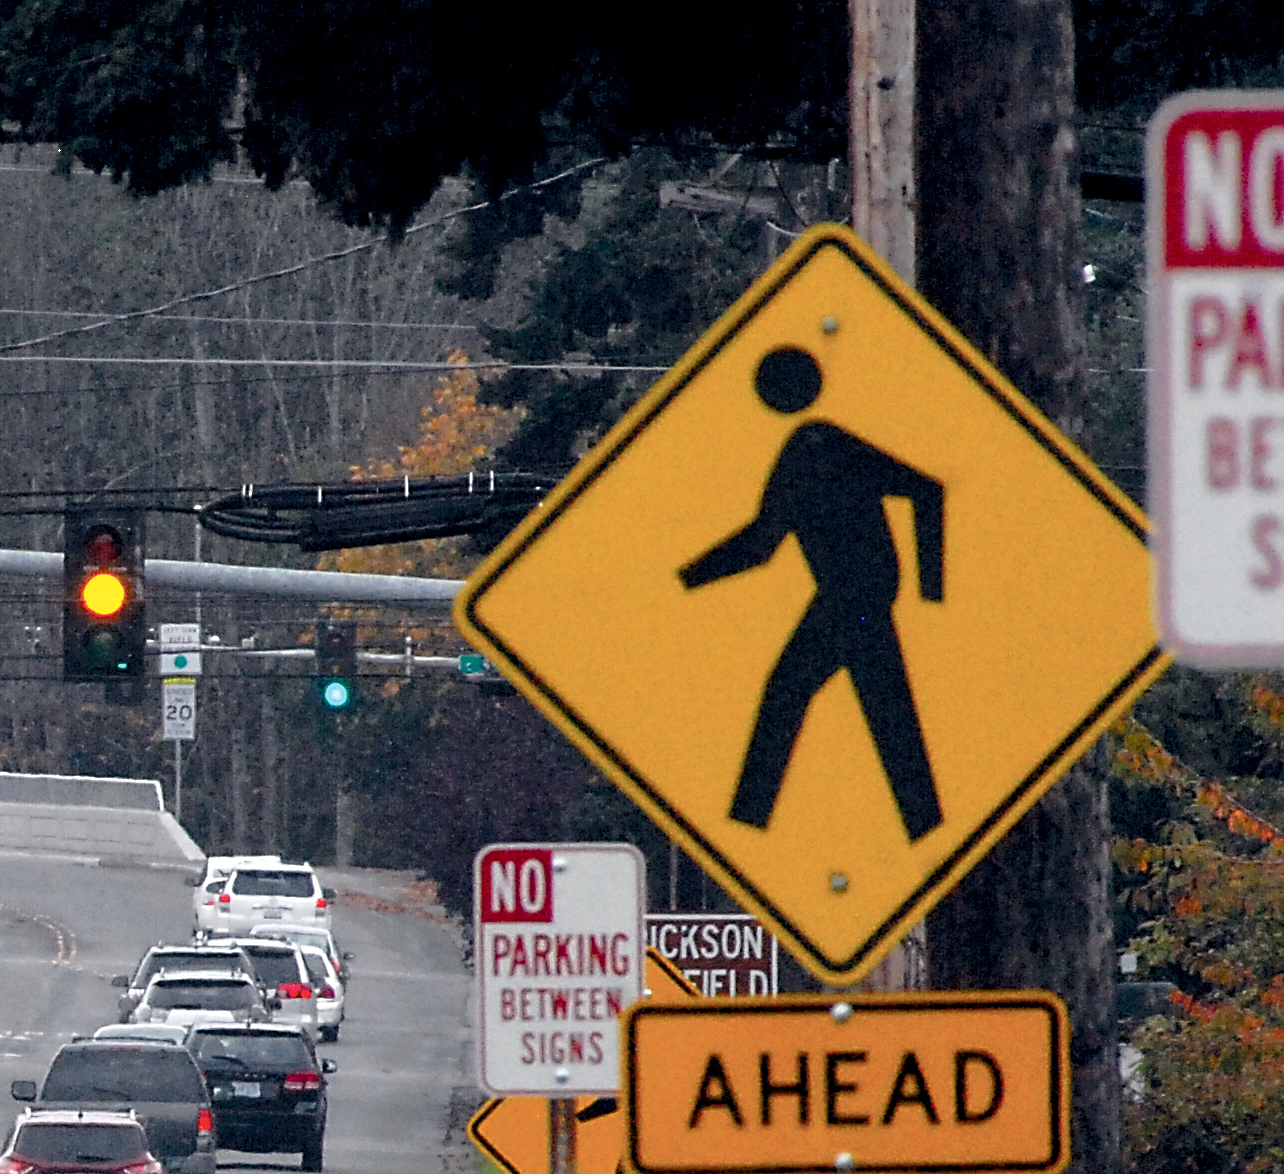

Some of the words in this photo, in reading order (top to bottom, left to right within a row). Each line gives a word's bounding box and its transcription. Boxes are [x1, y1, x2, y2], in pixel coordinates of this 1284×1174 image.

[166, 705, 192, 720] 20
[490, 859, 546, 914] NO
[493, 932, 629, 976] PARKING
[643, 924, 763, 959] ICKSON
[501, 988, 622, 1021] BETWEEN
[521, 1032, 603, 1064] SIGNS
[688, 1051, 1005, 1128] AHEAD
